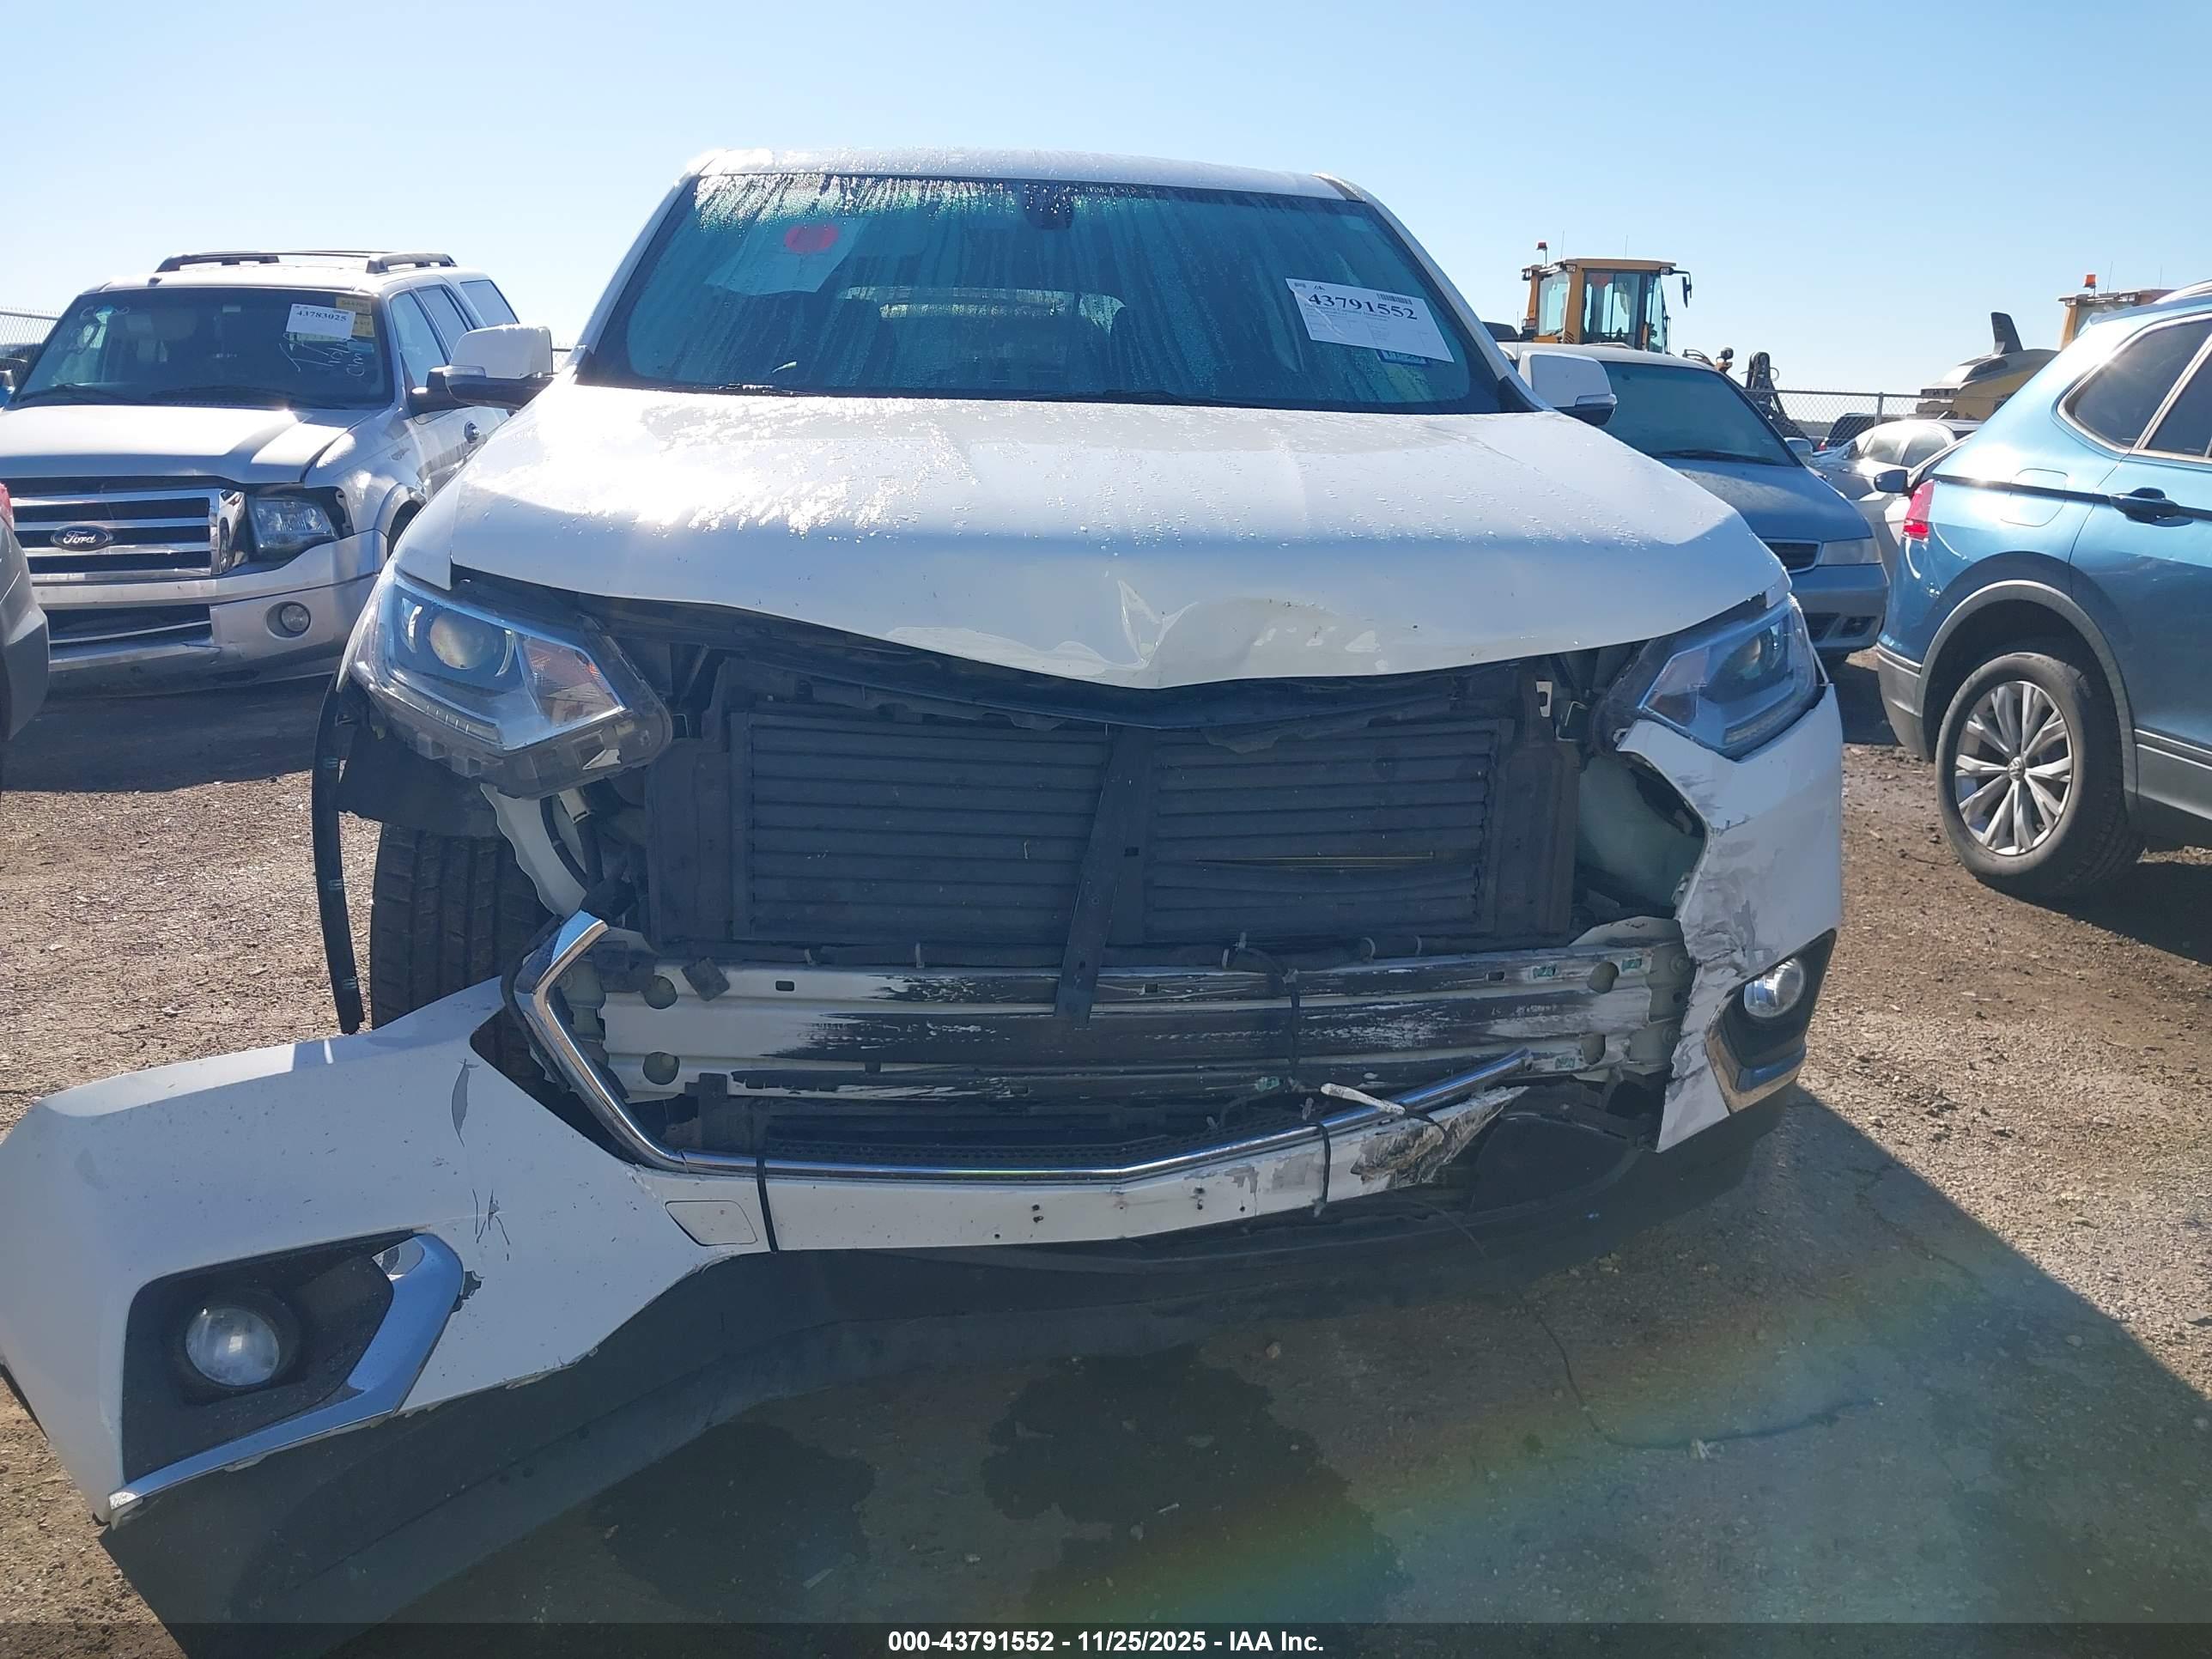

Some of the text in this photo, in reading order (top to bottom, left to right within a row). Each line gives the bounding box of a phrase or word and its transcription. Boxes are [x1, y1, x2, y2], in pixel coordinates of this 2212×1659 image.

[1308, 294, 1418, 320] 43791552
[296, 310, 348, 322] 43783025
[63, 530, 97, 544] Ford
